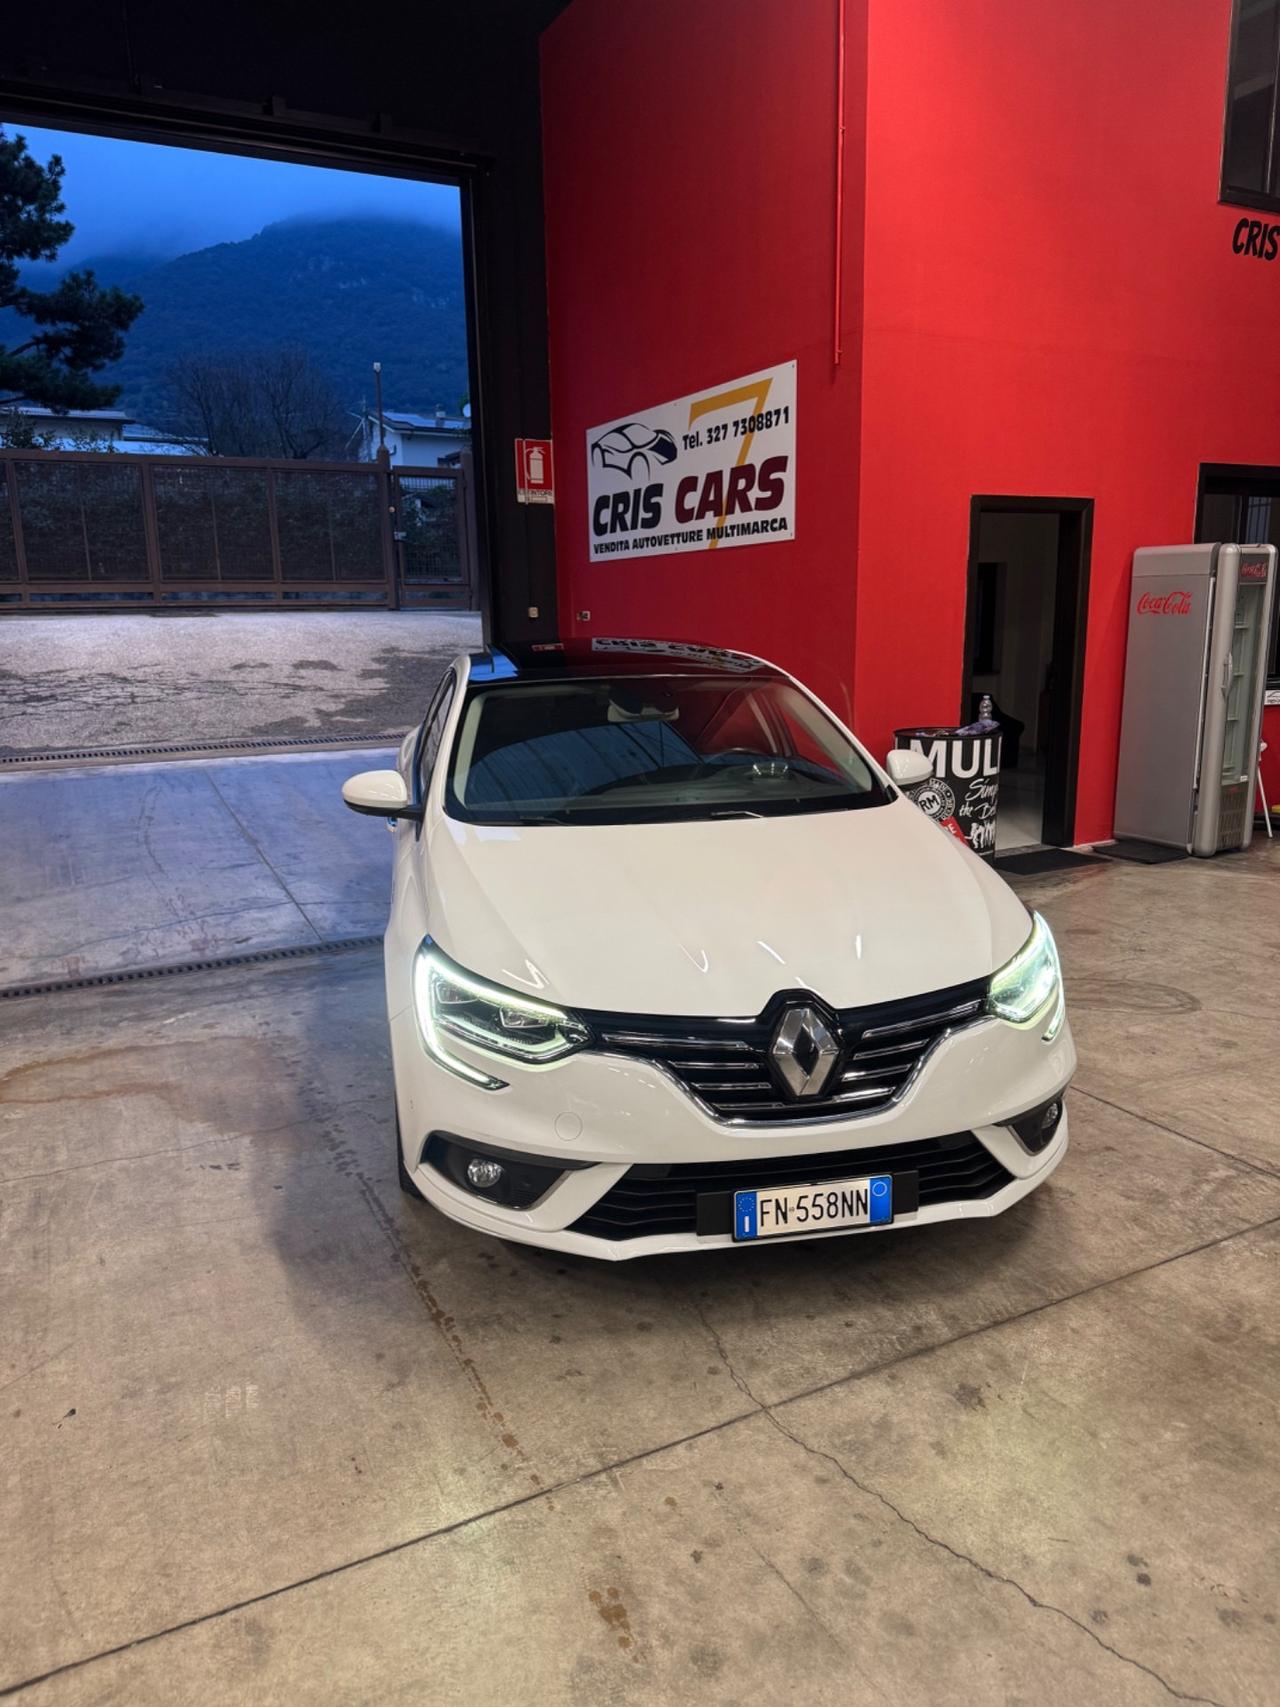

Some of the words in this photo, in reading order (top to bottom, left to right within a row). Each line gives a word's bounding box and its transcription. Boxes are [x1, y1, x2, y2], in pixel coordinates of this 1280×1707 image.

[1232, 217, 1280, 261] CRIS
[682, 433, 703, 451] Tel.
[706, 422, 728, 445] 327
[733, 406, 789, 437] 7308871
[593, 483, 664, 537] CRIS
[675, 455, 788, 524] CARS
[594, 533, 630, 555] VENDITA
[632, 528, 703, 550] AUTOVETTURE
[706, 517, 788, 540] MULTIMARCA
[910, 737, 1001, 778] MUL
[919, 794, 940, 811] RM
[744, 1216, 750, 1233] I
[760, 1198, 788, 1227] FN
[796, 1188, 868, 1222] 558NN
